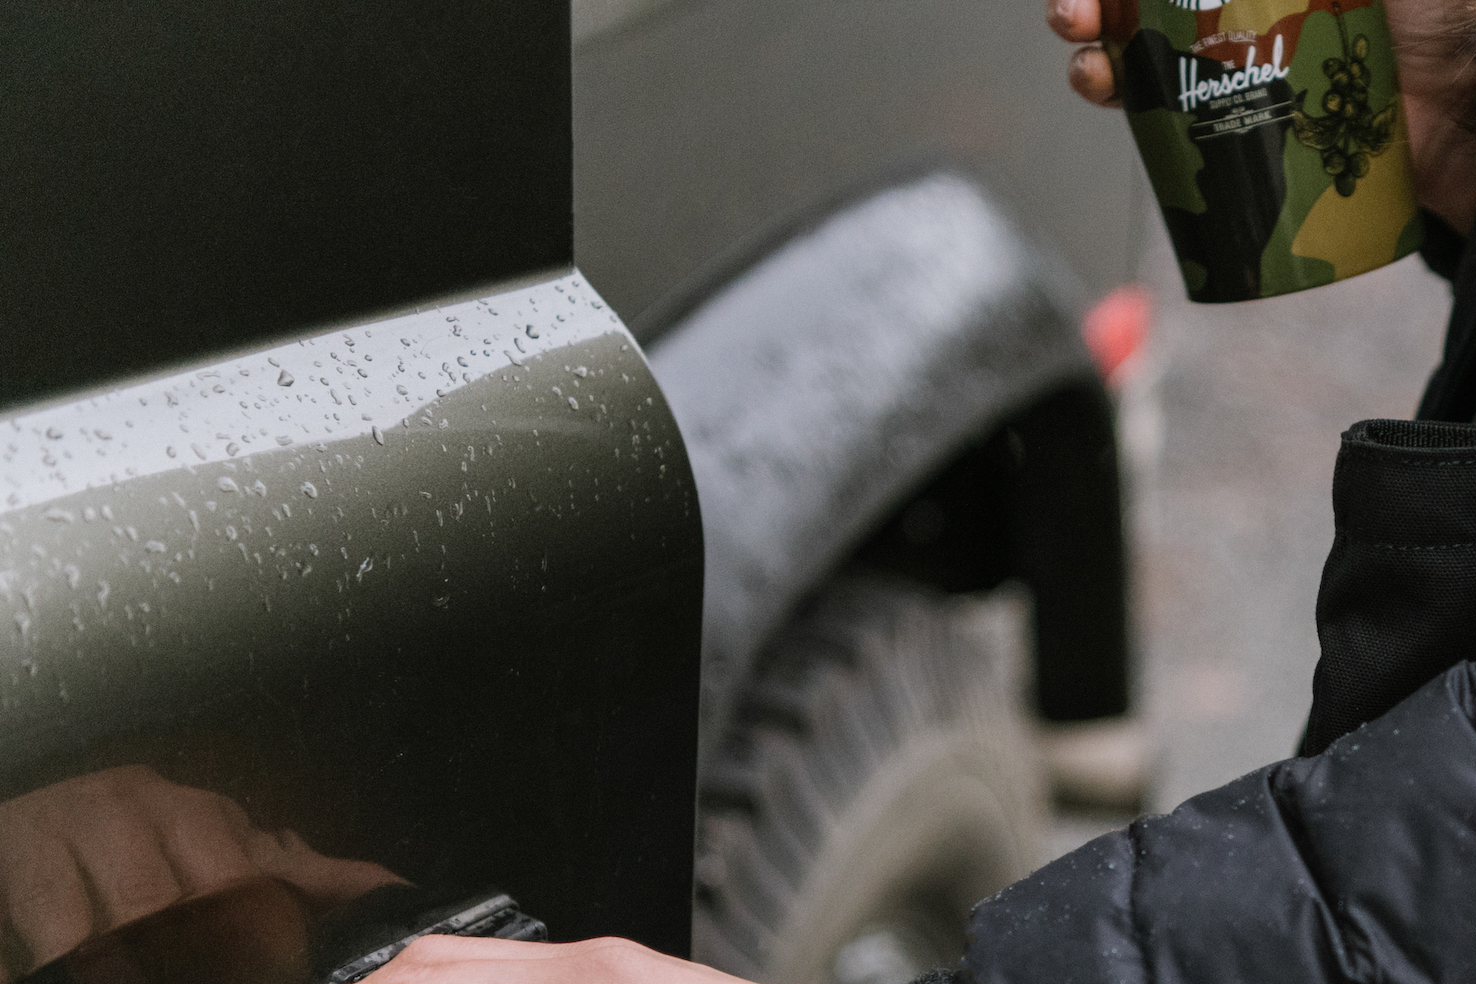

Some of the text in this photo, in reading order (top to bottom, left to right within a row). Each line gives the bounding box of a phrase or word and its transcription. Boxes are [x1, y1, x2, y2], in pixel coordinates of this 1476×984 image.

[1202, 32, 1226, 47] FINEST
[1228, 30, 1257, 42] QUALITY
[1178, 34, 1289, 112] Herschel
[1221, 60, 1235, 70] THE
[1213, 111, 1272, 132] TRADE MARK
